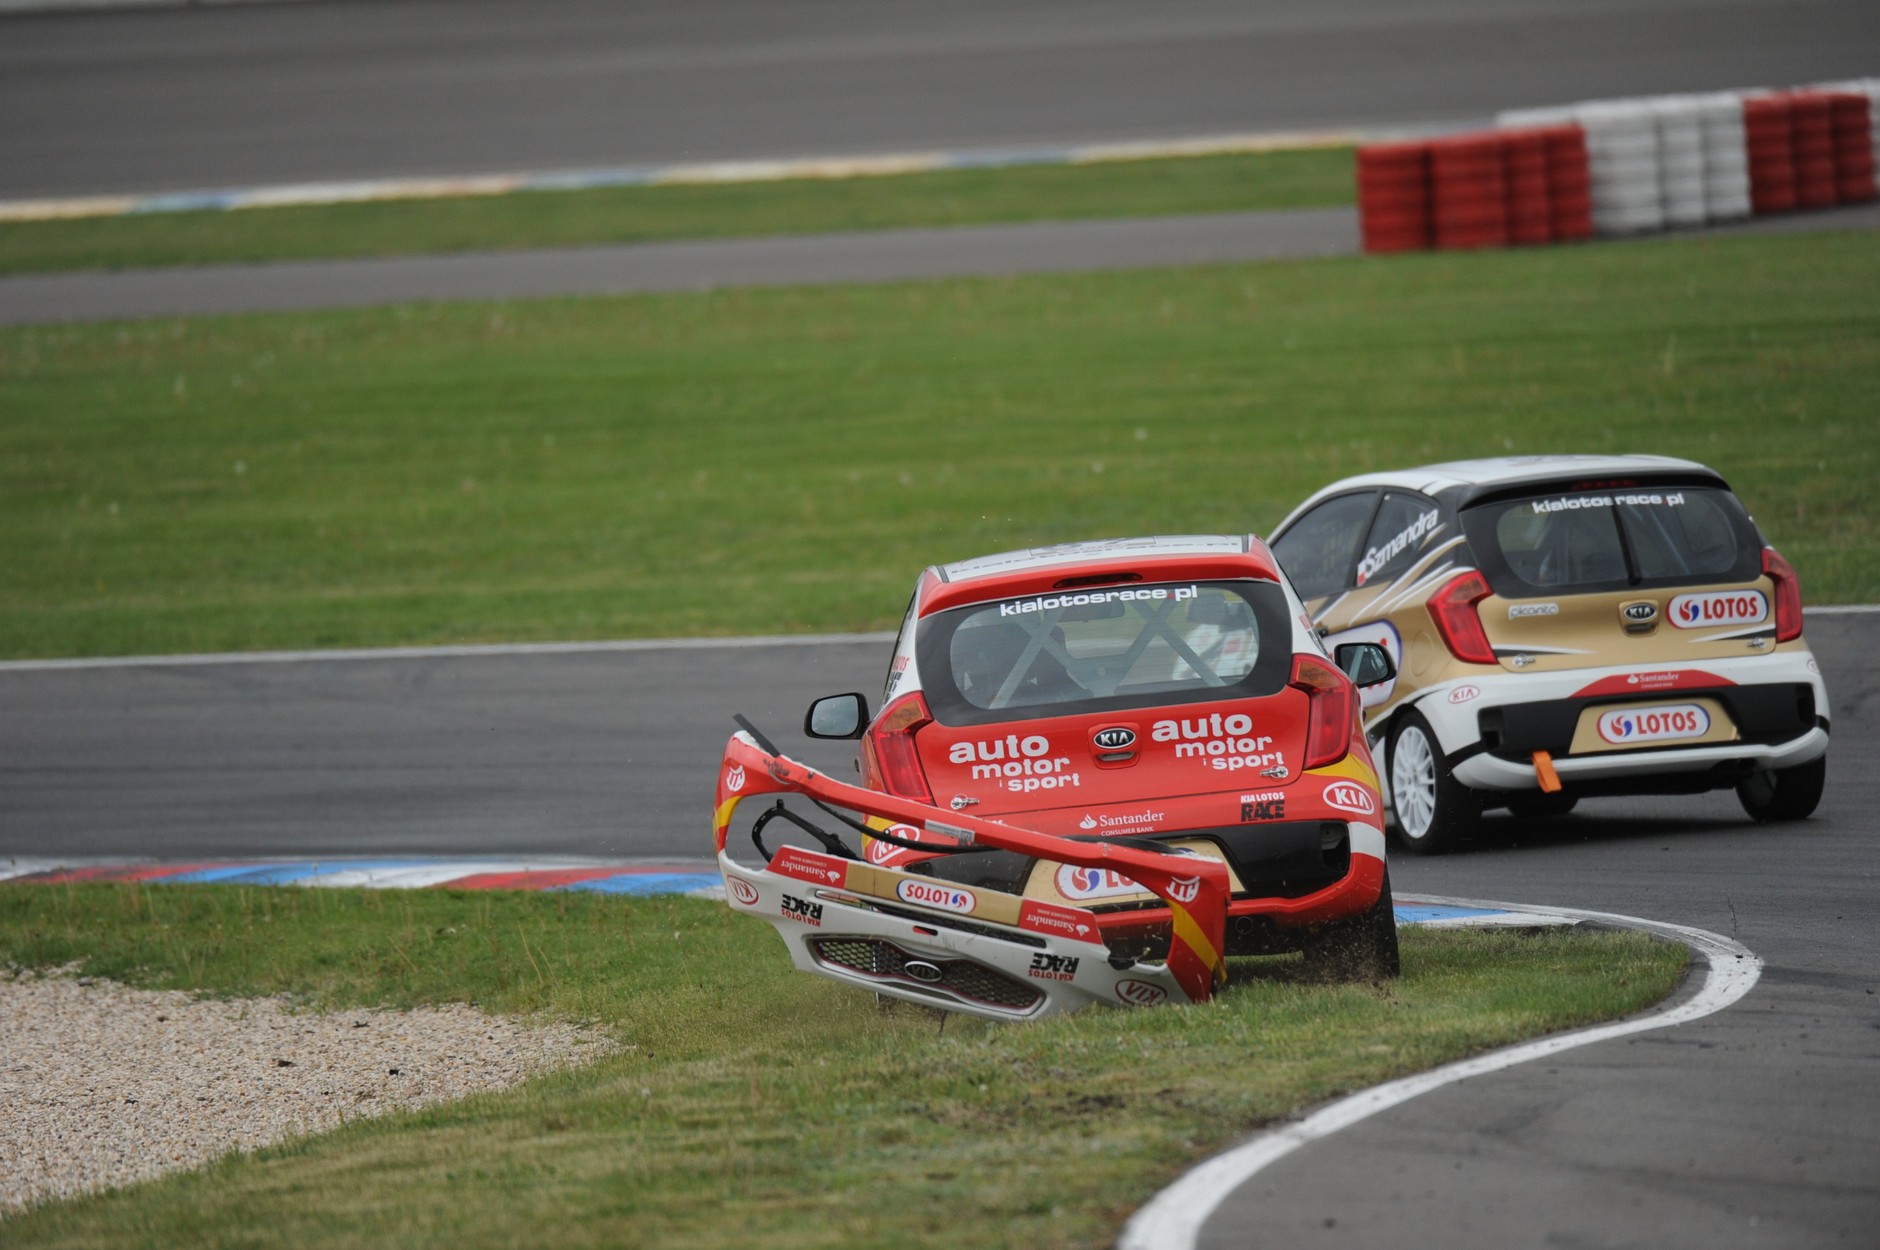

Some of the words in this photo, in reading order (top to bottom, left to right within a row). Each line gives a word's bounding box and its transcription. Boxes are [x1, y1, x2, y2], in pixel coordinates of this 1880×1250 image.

[1365, 508, 1439, 580] Szmandra
[999, 584, 1198, 617] kialotosrace.pl
[1703, 596, 1758, 620] LOTOS
[1628, 607, 1652, 620] KIA
[1639, 671, 1679, 683] Santander
[1452, 688, 1474, 701] KIA
[1151, 713, 1253, 742] auto
[1636, 710, 1697, 735] LOTOS
[1099, 731, 1129, 746] KIA
[1175, 736, 1273, 758] motor
[949, 734, 1050, 764] auto
[972, 757, 1071, 780] motor
[1211, 751, 1285, 771] sport
[1007, 773, 1080, 793] sport
[1256, 791, 1285, 802] LOTOS
[1333, 787, 1371, 810] KIA
[1099, 809, 1165, 827] Santander
[1240, 799, 1286, 822] RACE
[1101, 827, 1136, 837] CONSUMER
[1136, 826, 1155, 834] BANK
[780, 859, 826, 879] Santander
[729, 879, 753, 899] KIA
[906, 884, 950, 905] LOTOS
[781, 893, 824, 920] RACE
[781, 908, 807, 923] LOTOS
[1026, 914, 1076, 933] Santander
[1029, 952, 1080, 974] RACE
[1028, 969, 1059, 980] LOTOS
[1124, 981, 1161, 1003] KIA
